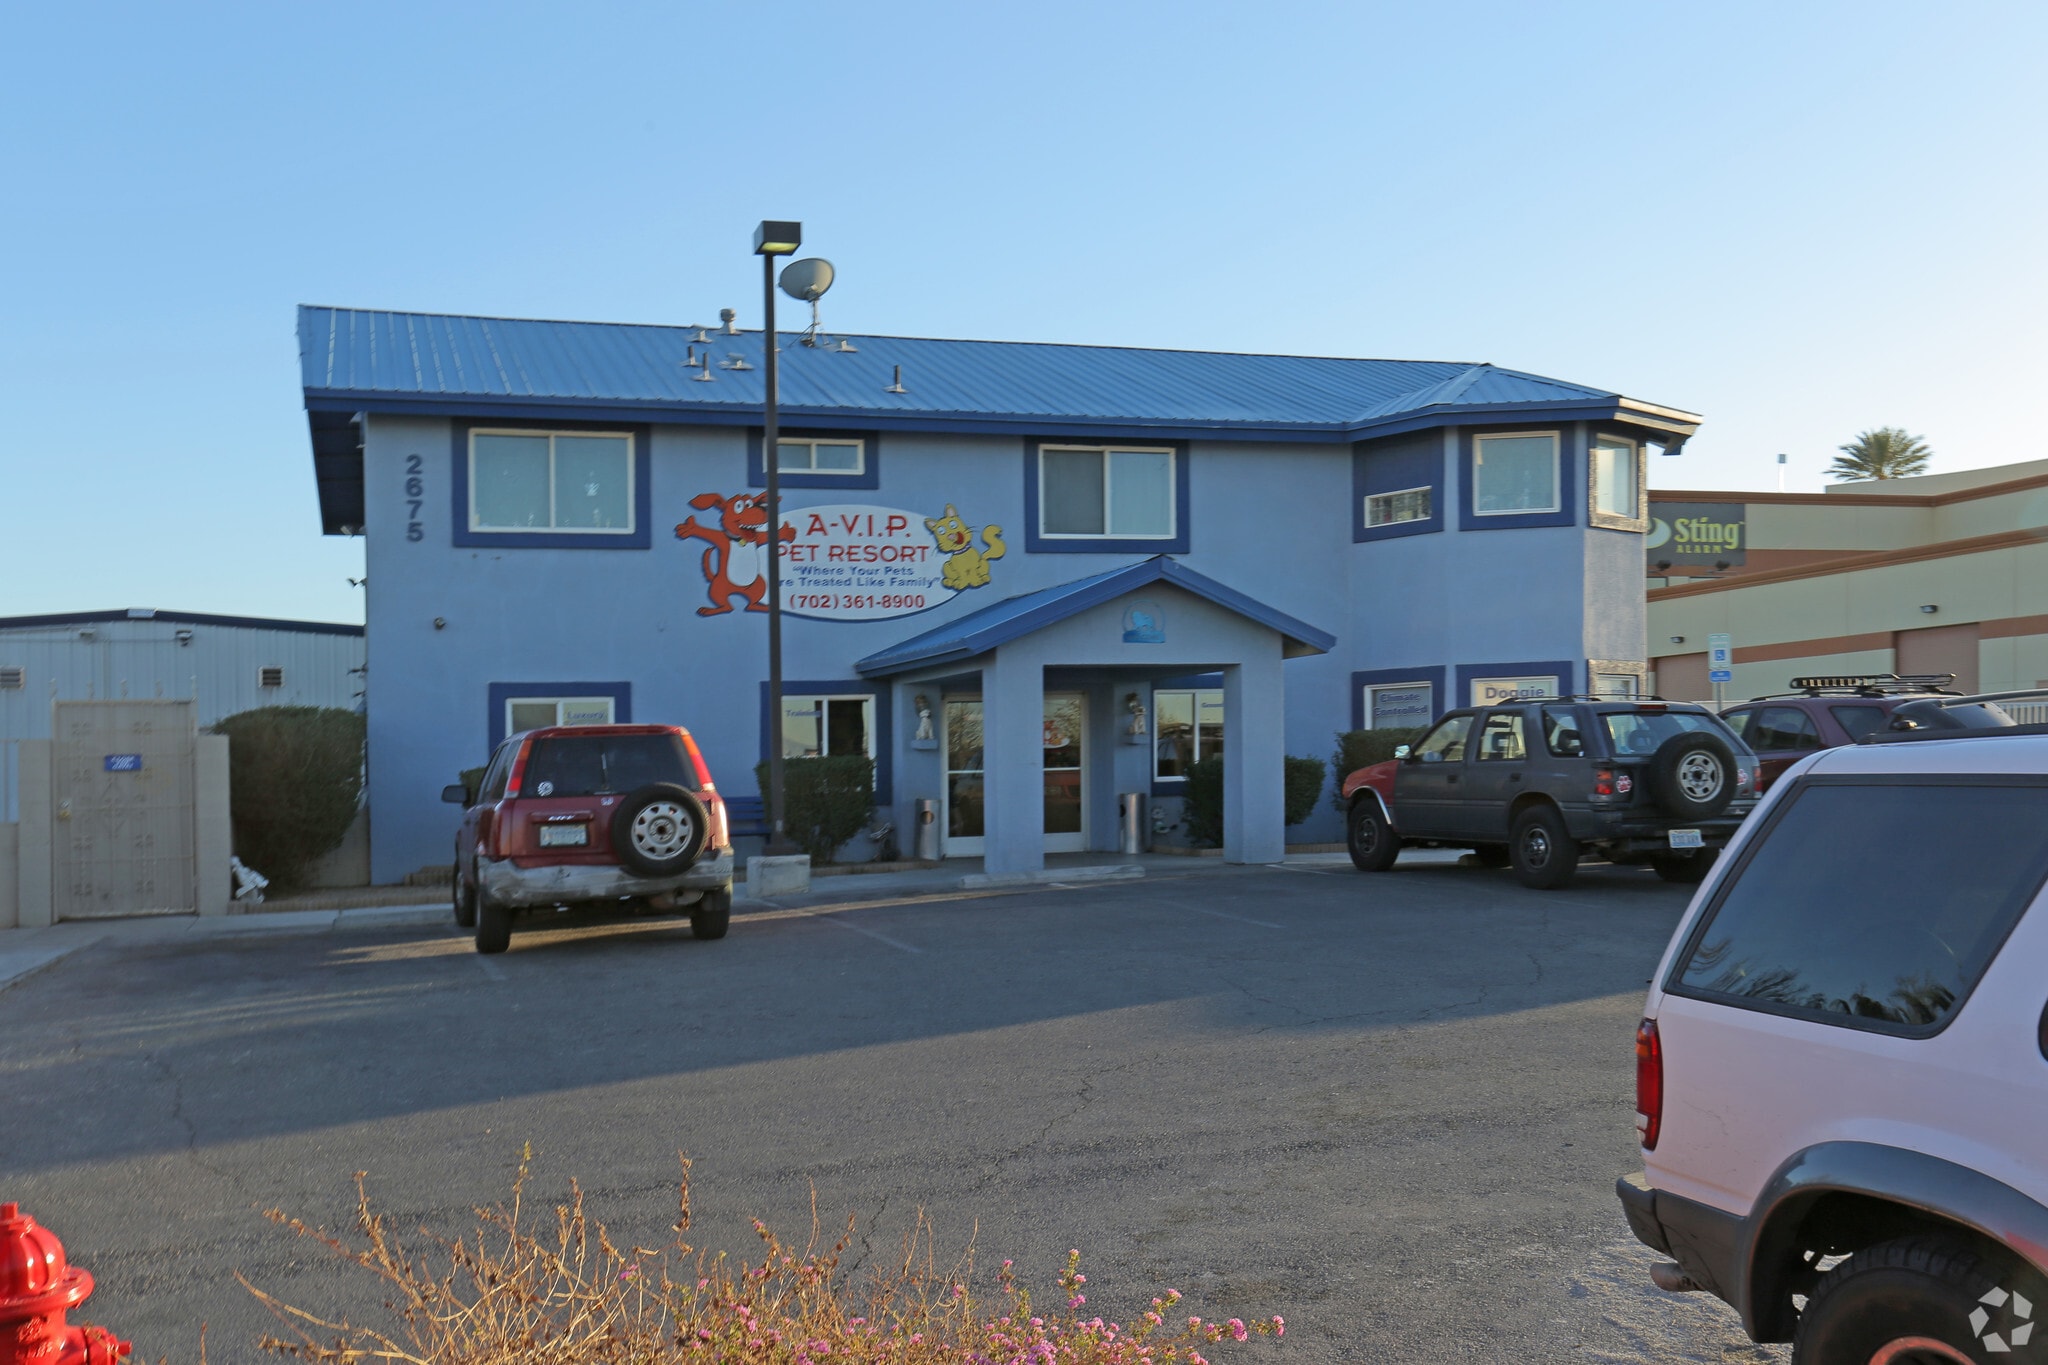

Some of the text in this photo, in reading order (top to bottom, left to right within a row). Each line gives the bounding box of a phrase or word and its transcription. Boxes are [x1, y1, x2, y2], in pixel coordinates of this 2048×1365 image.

[406, 453, 424, 543] 2675
[1674, 517, 1739, 550] Sting
[828, 545, 929, 562] RESORT
[1676, 545, 1723, 554] ALARM
[850, 567, 880, 576] Your
[884, 567, 915, 576] Pets
[798, 577, 851, 587] Treated
[857, 577, 885, 587] Like
[1485, 686, 1545, 700] Doggie
